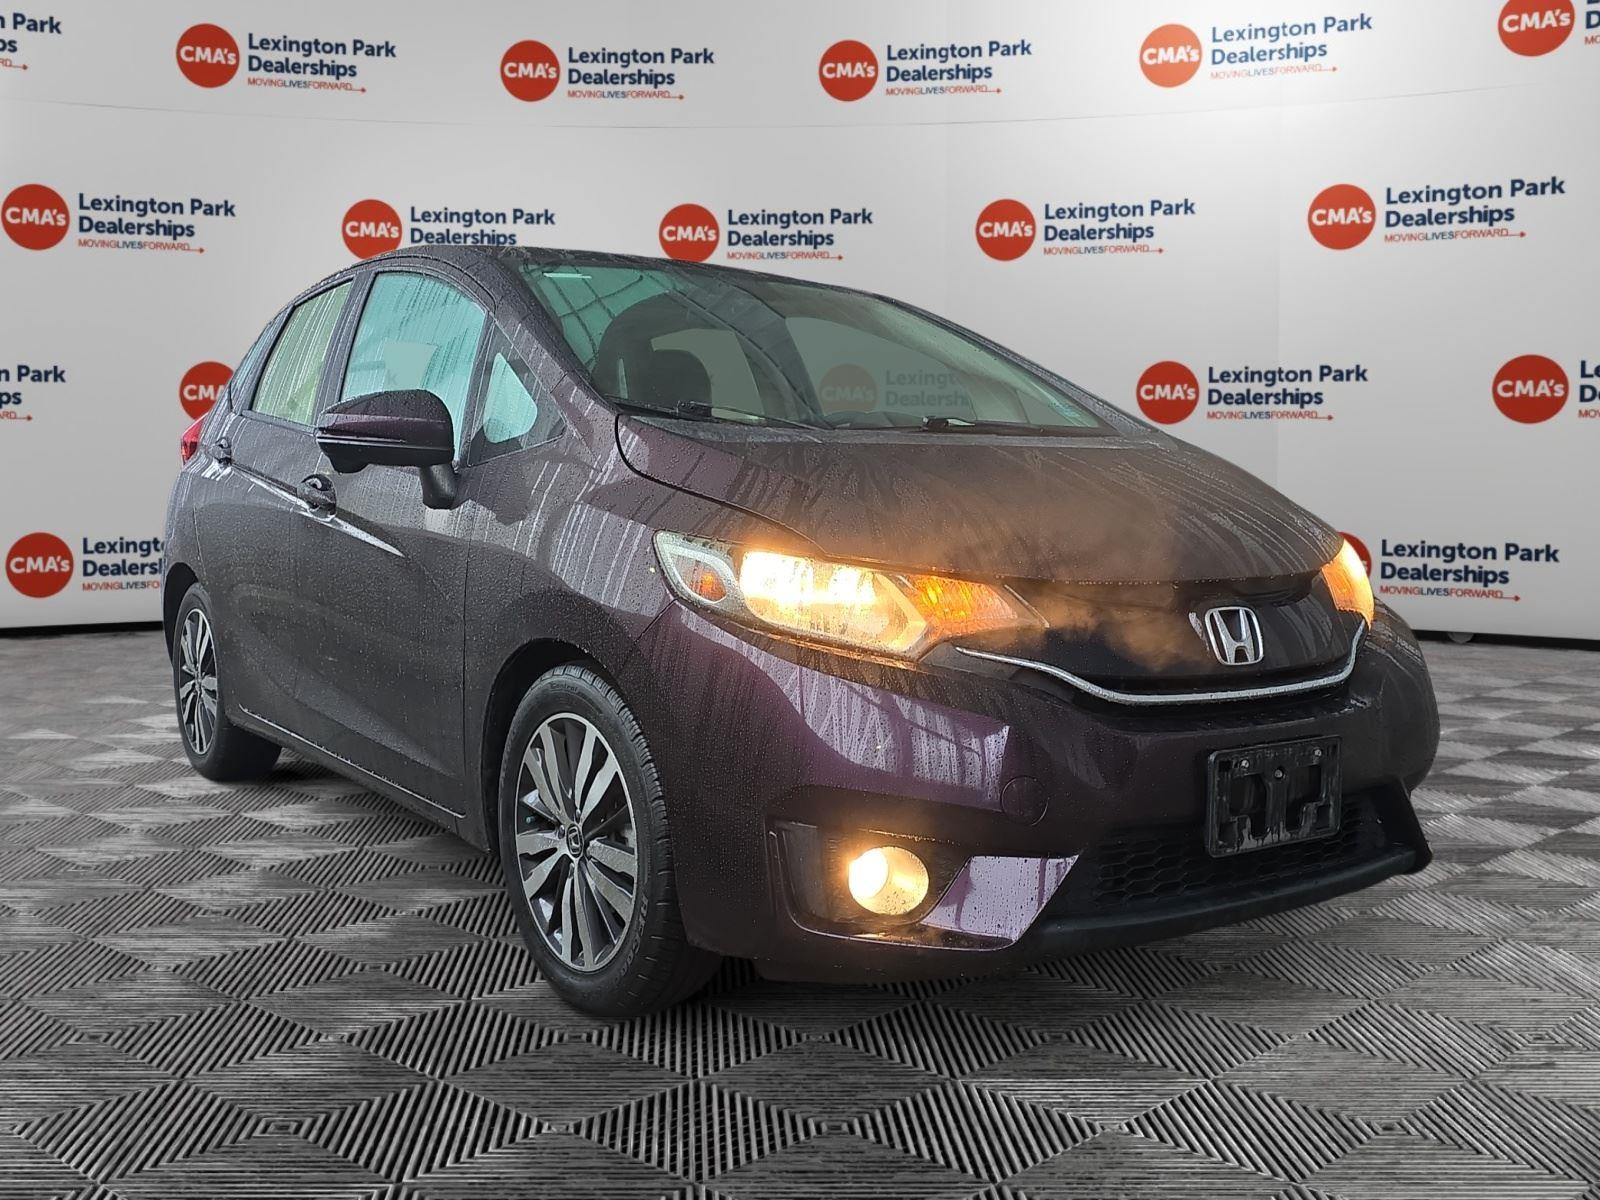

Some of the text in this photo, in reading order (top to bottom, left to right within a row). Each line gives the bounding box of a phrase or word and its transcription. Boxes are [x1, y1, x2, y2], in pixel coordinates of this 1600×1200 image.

[13, 12, 62, 35] Park
[1212, 13, 1372, 44] Lexington Park
[1502, 9, 1571, 33] CMA's
[180, 45, 237, 65] CMA's
[248, 33, 396, 58] Lexington Park
[886, 40, 1032, 64] Lexington Park
[1142, 45, 1199, 65] CMA's
[1211, 43, 1327, 66] Dealerships
[248, 55, 357, 78] Dealerships
[568, 47, 714, 68] Lexington Park
[503, 62, 557, 79] CMA's
[568, 68, 675, 88] Dealerships
[822, 62, 876, 79] CMA's
[886, 64, 992, 83] Dealerships
[1386, 176, 1565, 209] Lexington Park
[79, 193, 236, 218] Lexington Park
[1044, 198, 1195, 222] Lexington Park
[5, 207, 66, 227] CMA's
[410, 206, 556, 228] Lexington Park
[727, 208, 873, 229] Lexington Park
[1311, 206, 1372, 226] CMA's
[1385, 206, 1515, 228] Dealerships
[79, 216, 195, 240] Dealerships
[345, 221, 400, 239] CMA's
[410, 228, 517, 246] Dealerships
[662, 225, 717, 242] CMA's
[979, 221, 1033, 239] CMA's
[1044, 222, 1154, 243] Dealerships
[727, 229, 834, 249] Dealerships
[17, 364, 66, 383] Park
[886, 369, 958, 389] Lexingt
[1208, 365, 1368, 387] Lexington Park
[1140, 385, 1196, 401] CMA's
[1207, 387, 1323, 408] Dealerships
[1497, 380, 1564, 398] CMA's
[83, 537, 164, 557] Lexingt
[1381, 539, 1559, 563] Lexington Park
[10, 556, 70, 574] CMA's
[1380, 563, 1509, 586] Dealerships
[82, 581, 160, 592] MOVINGLIVESFO
